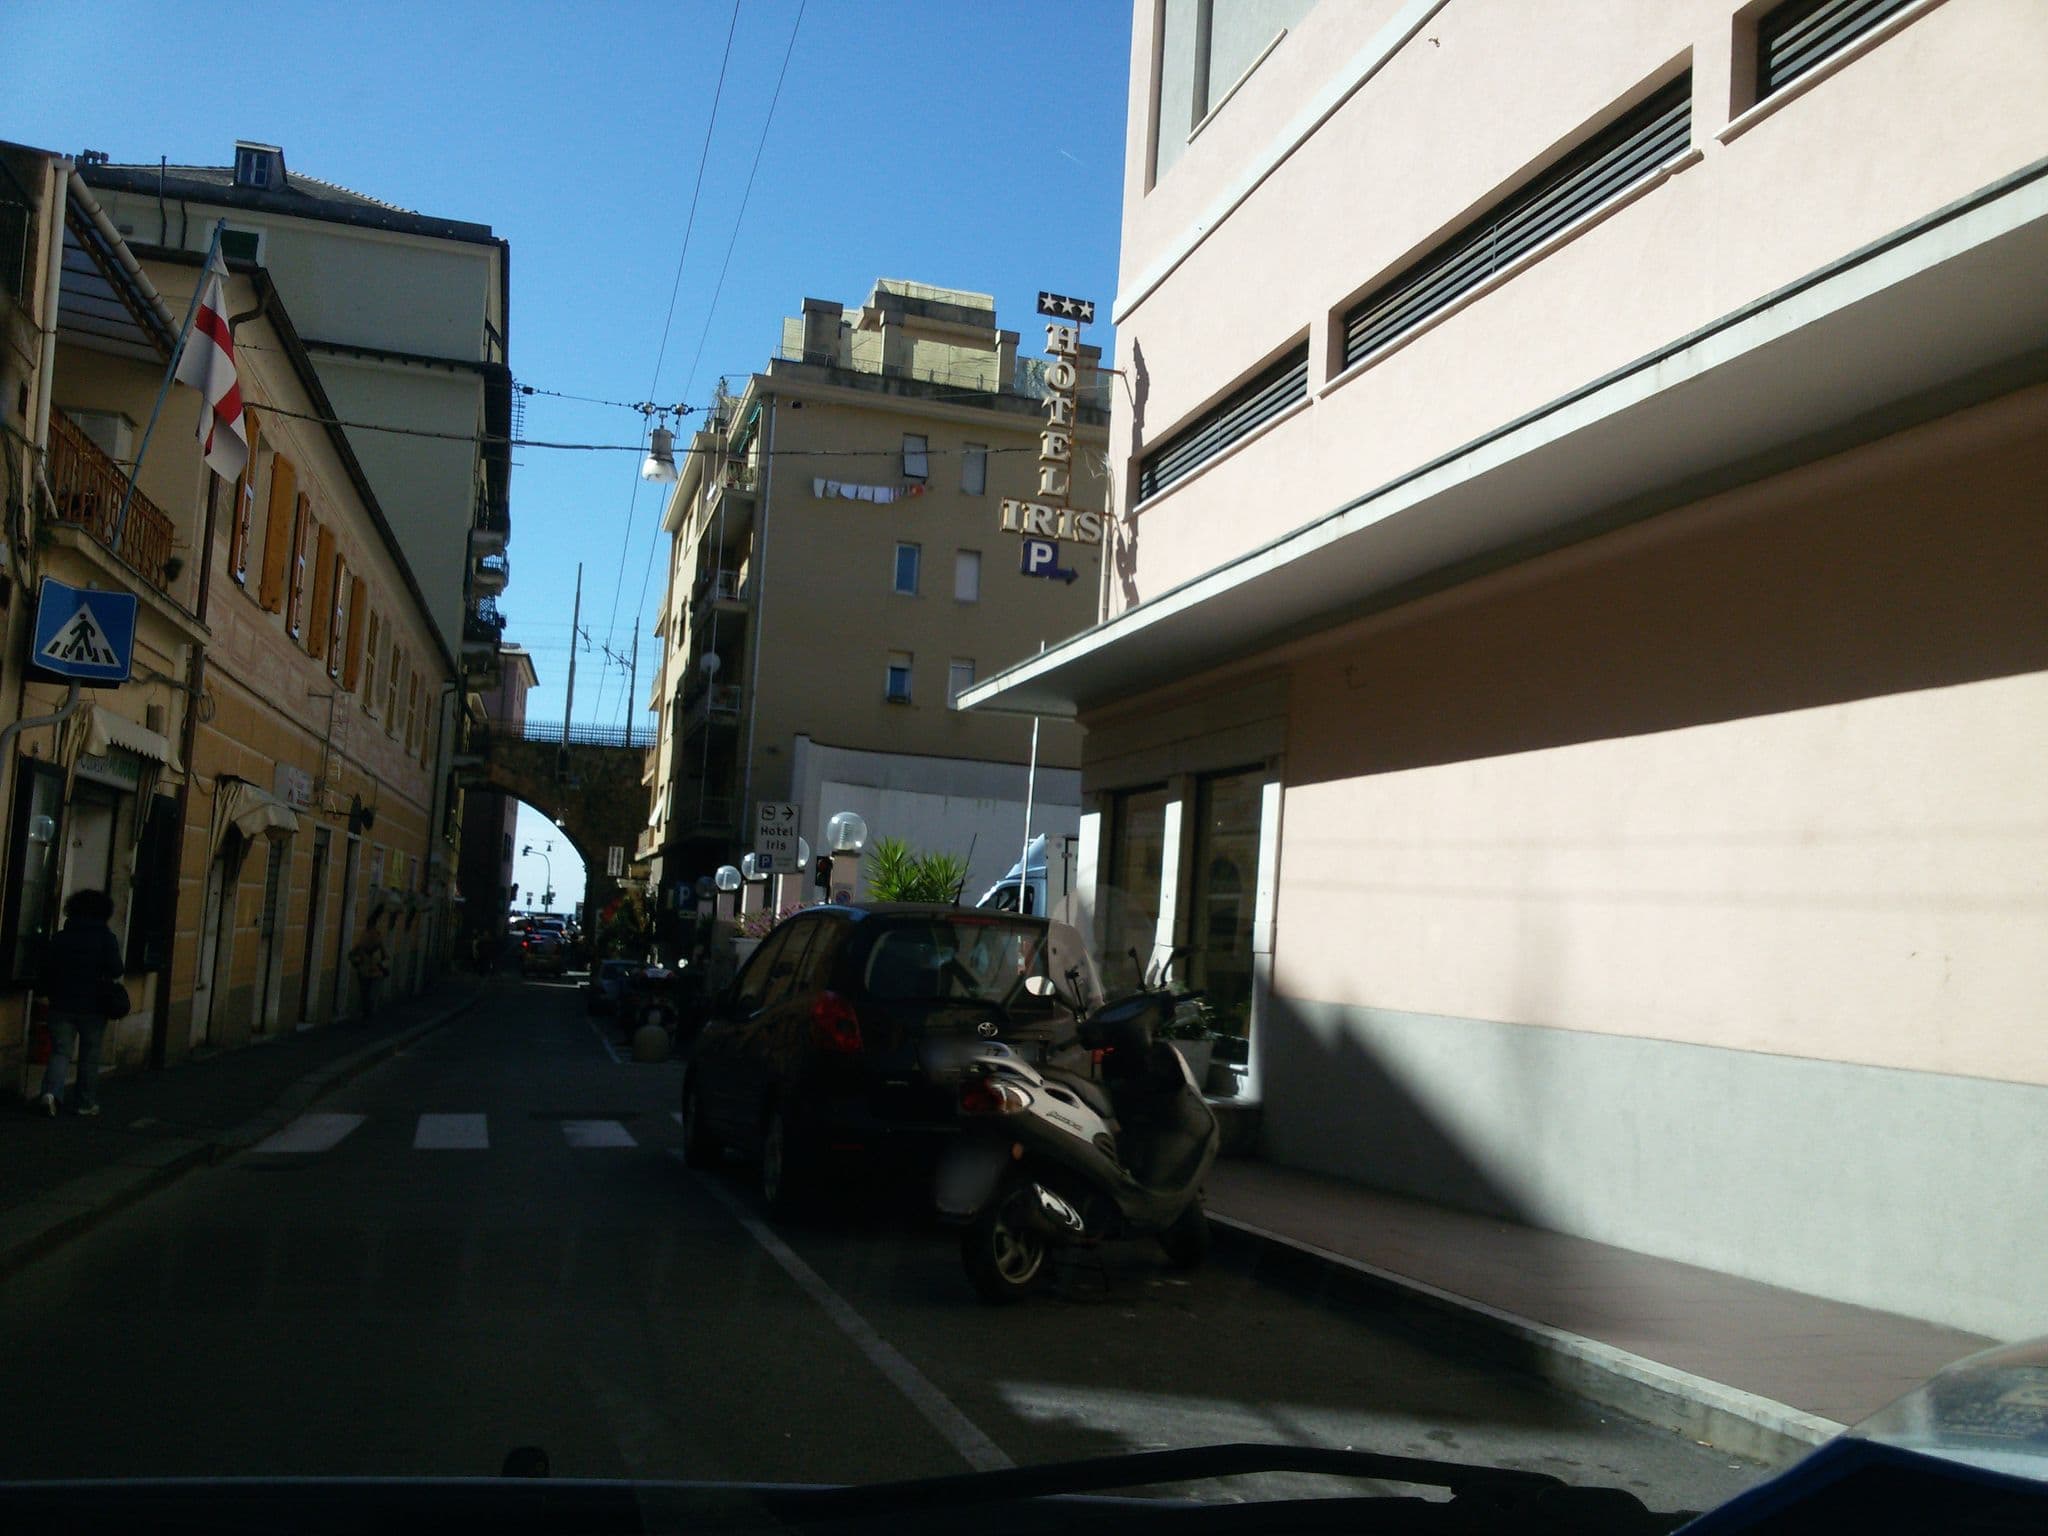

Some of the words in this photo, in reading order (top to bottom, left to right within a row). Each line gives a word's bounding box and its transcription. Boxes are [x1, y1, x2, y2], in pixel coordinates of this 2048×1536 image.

[1038, 323, 1079, 497] HOTEL
[1000, 498, 1101, 544] IRIS
[1029, 542, 1054, 572] P
[760, 826, 793, 836] Hotel
[766, 840, 786, 850] Iris
